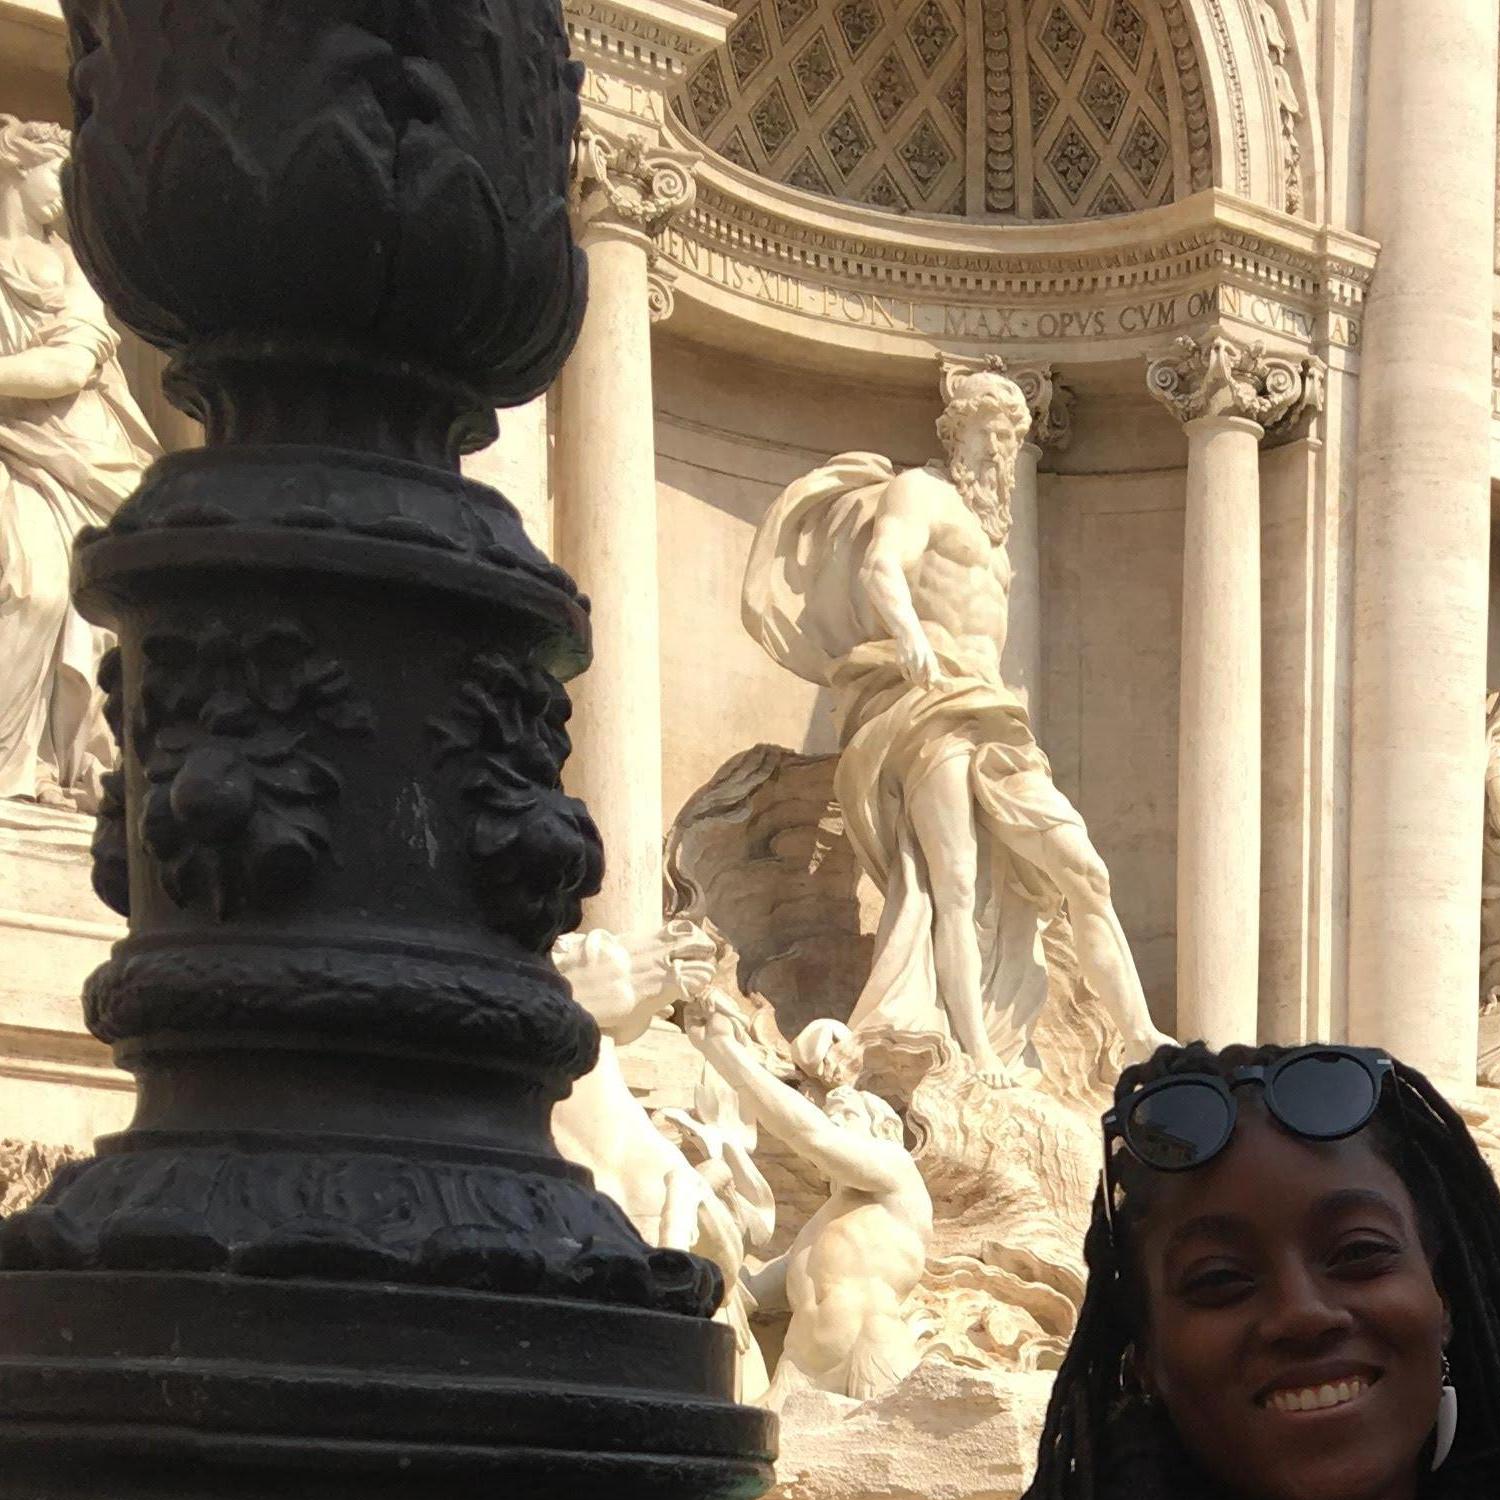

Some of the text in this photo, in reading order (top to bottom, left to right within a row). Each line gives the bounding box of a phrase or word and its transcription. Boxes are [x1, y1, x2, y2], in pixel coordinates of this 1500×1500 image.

[944, 304, 1019, 338] MAX
[1037, 311, 1106, 338] OPVS
[1118, 300, 1176, 333] CVM
